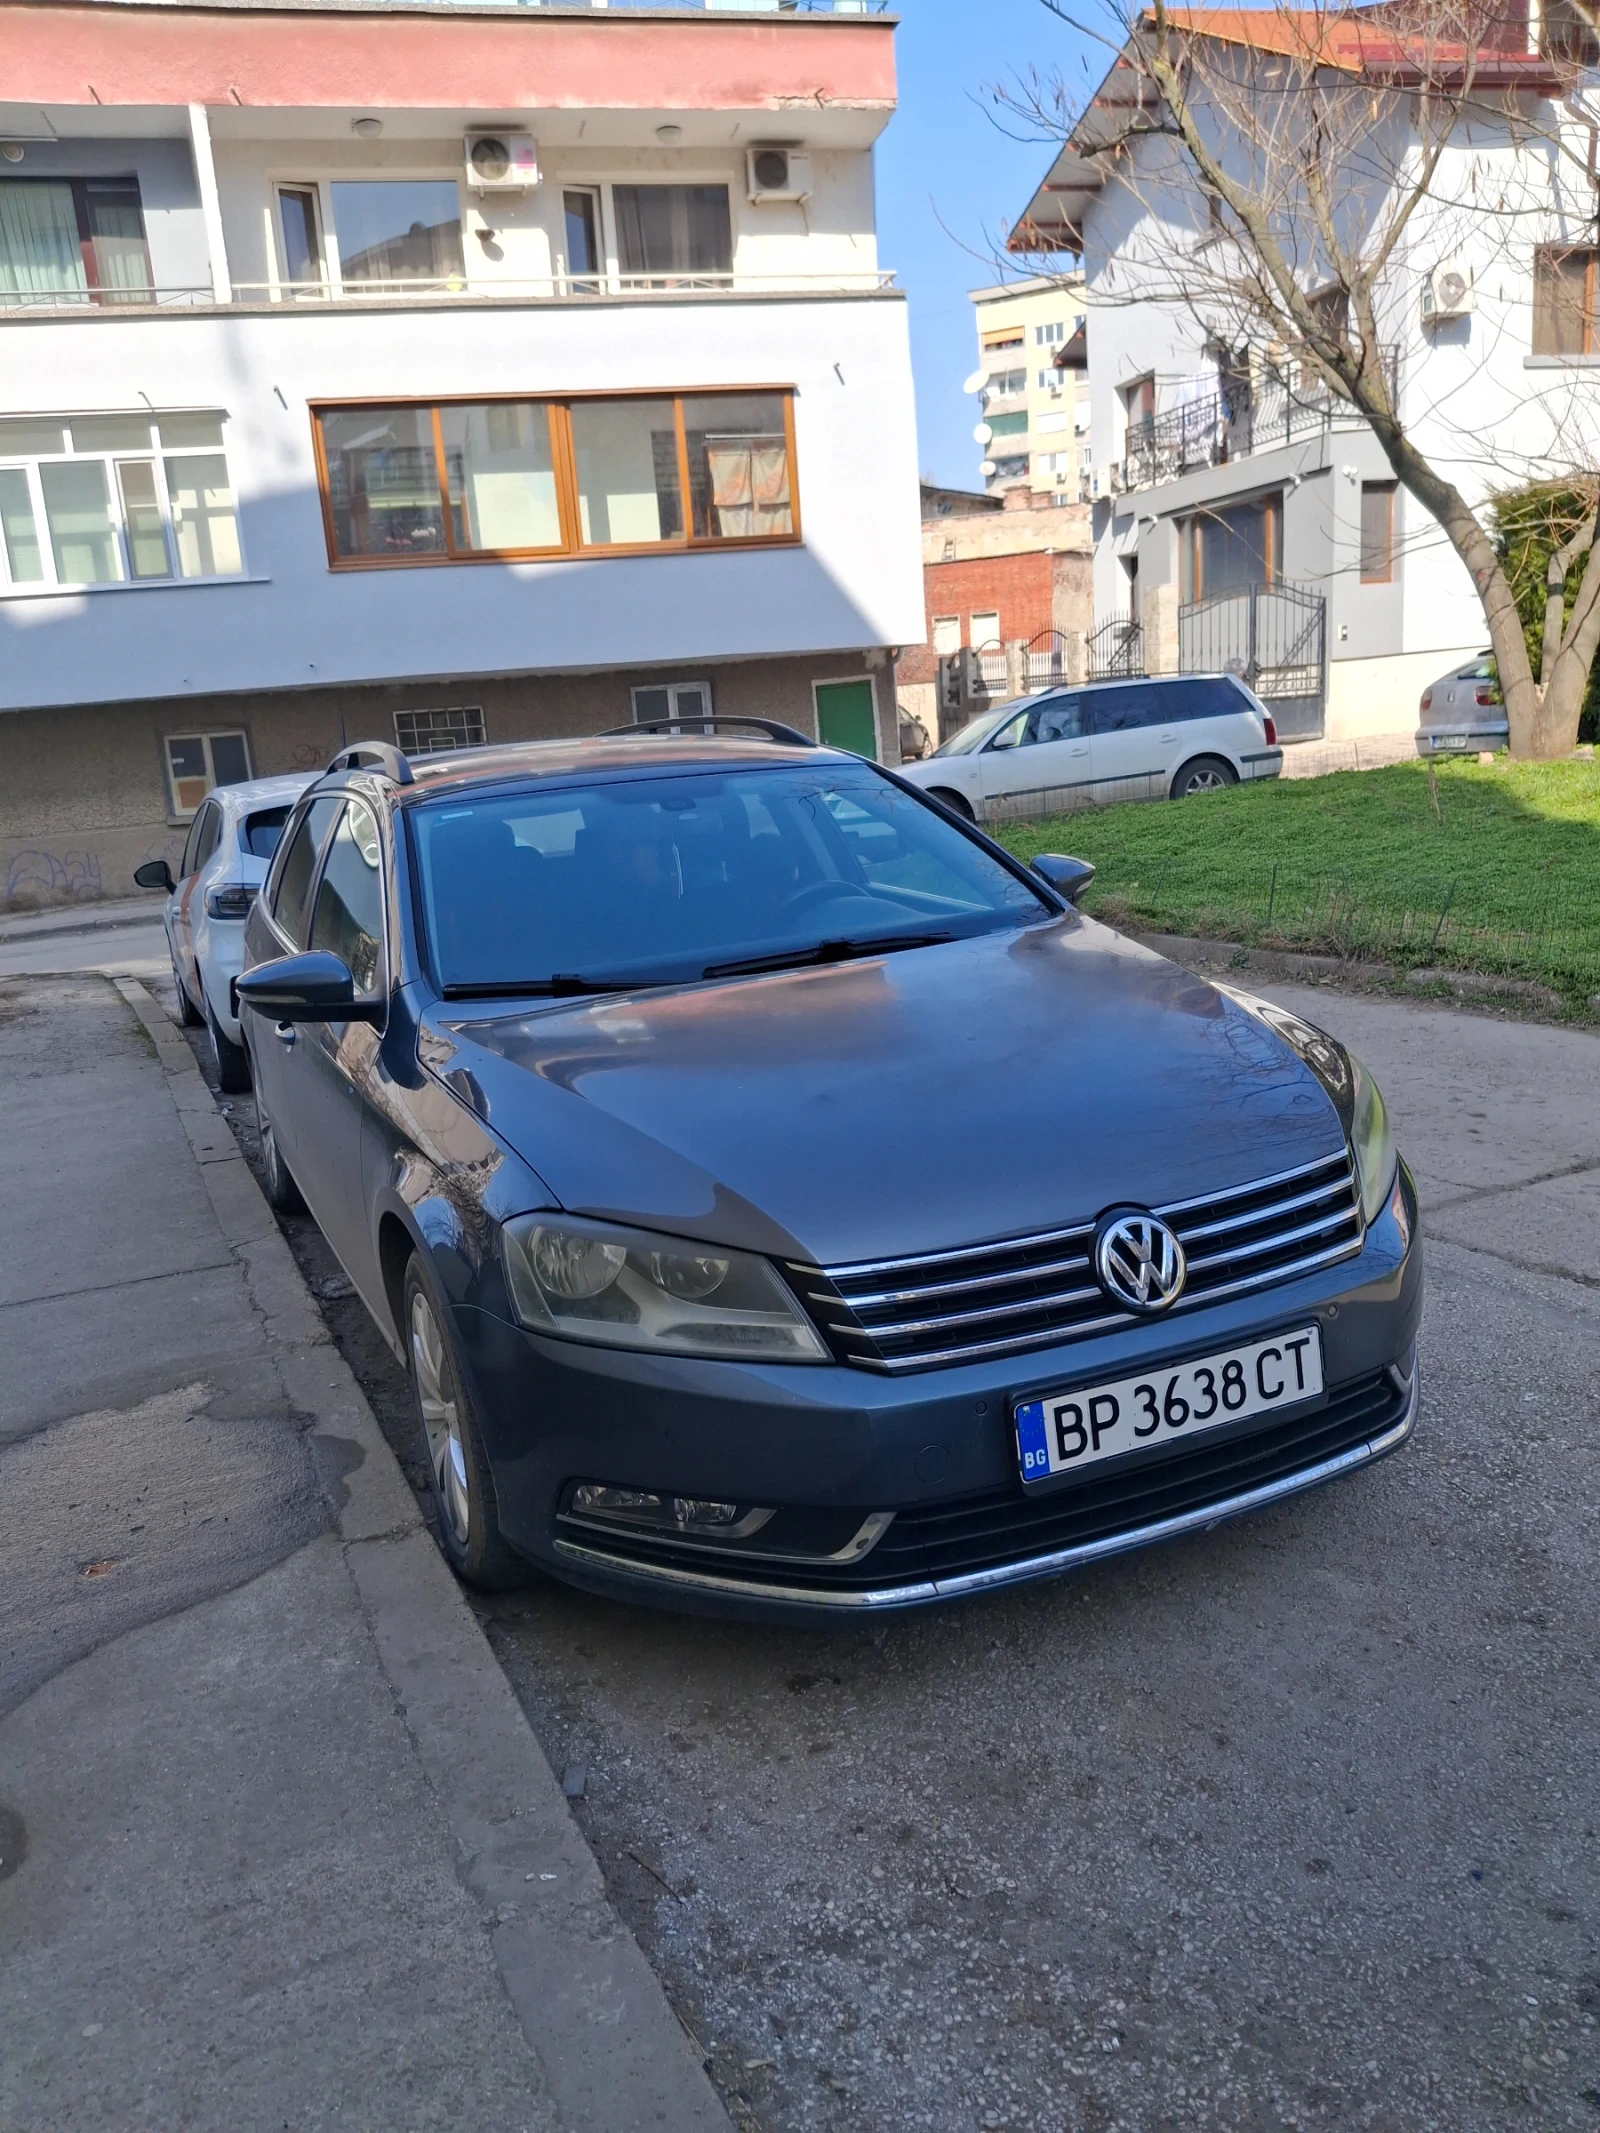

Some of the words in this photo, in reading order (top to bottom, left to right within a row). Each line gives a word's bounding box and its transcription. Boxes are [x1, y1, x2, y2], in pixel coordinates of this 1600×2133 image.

[1053, 1394, 1119, 1461] BP
[1133, 1359, 1247, 1437] 3638
[1256, 1337, 1311, 1400] CT
[1024, 1448, 1046, 1469] BG
